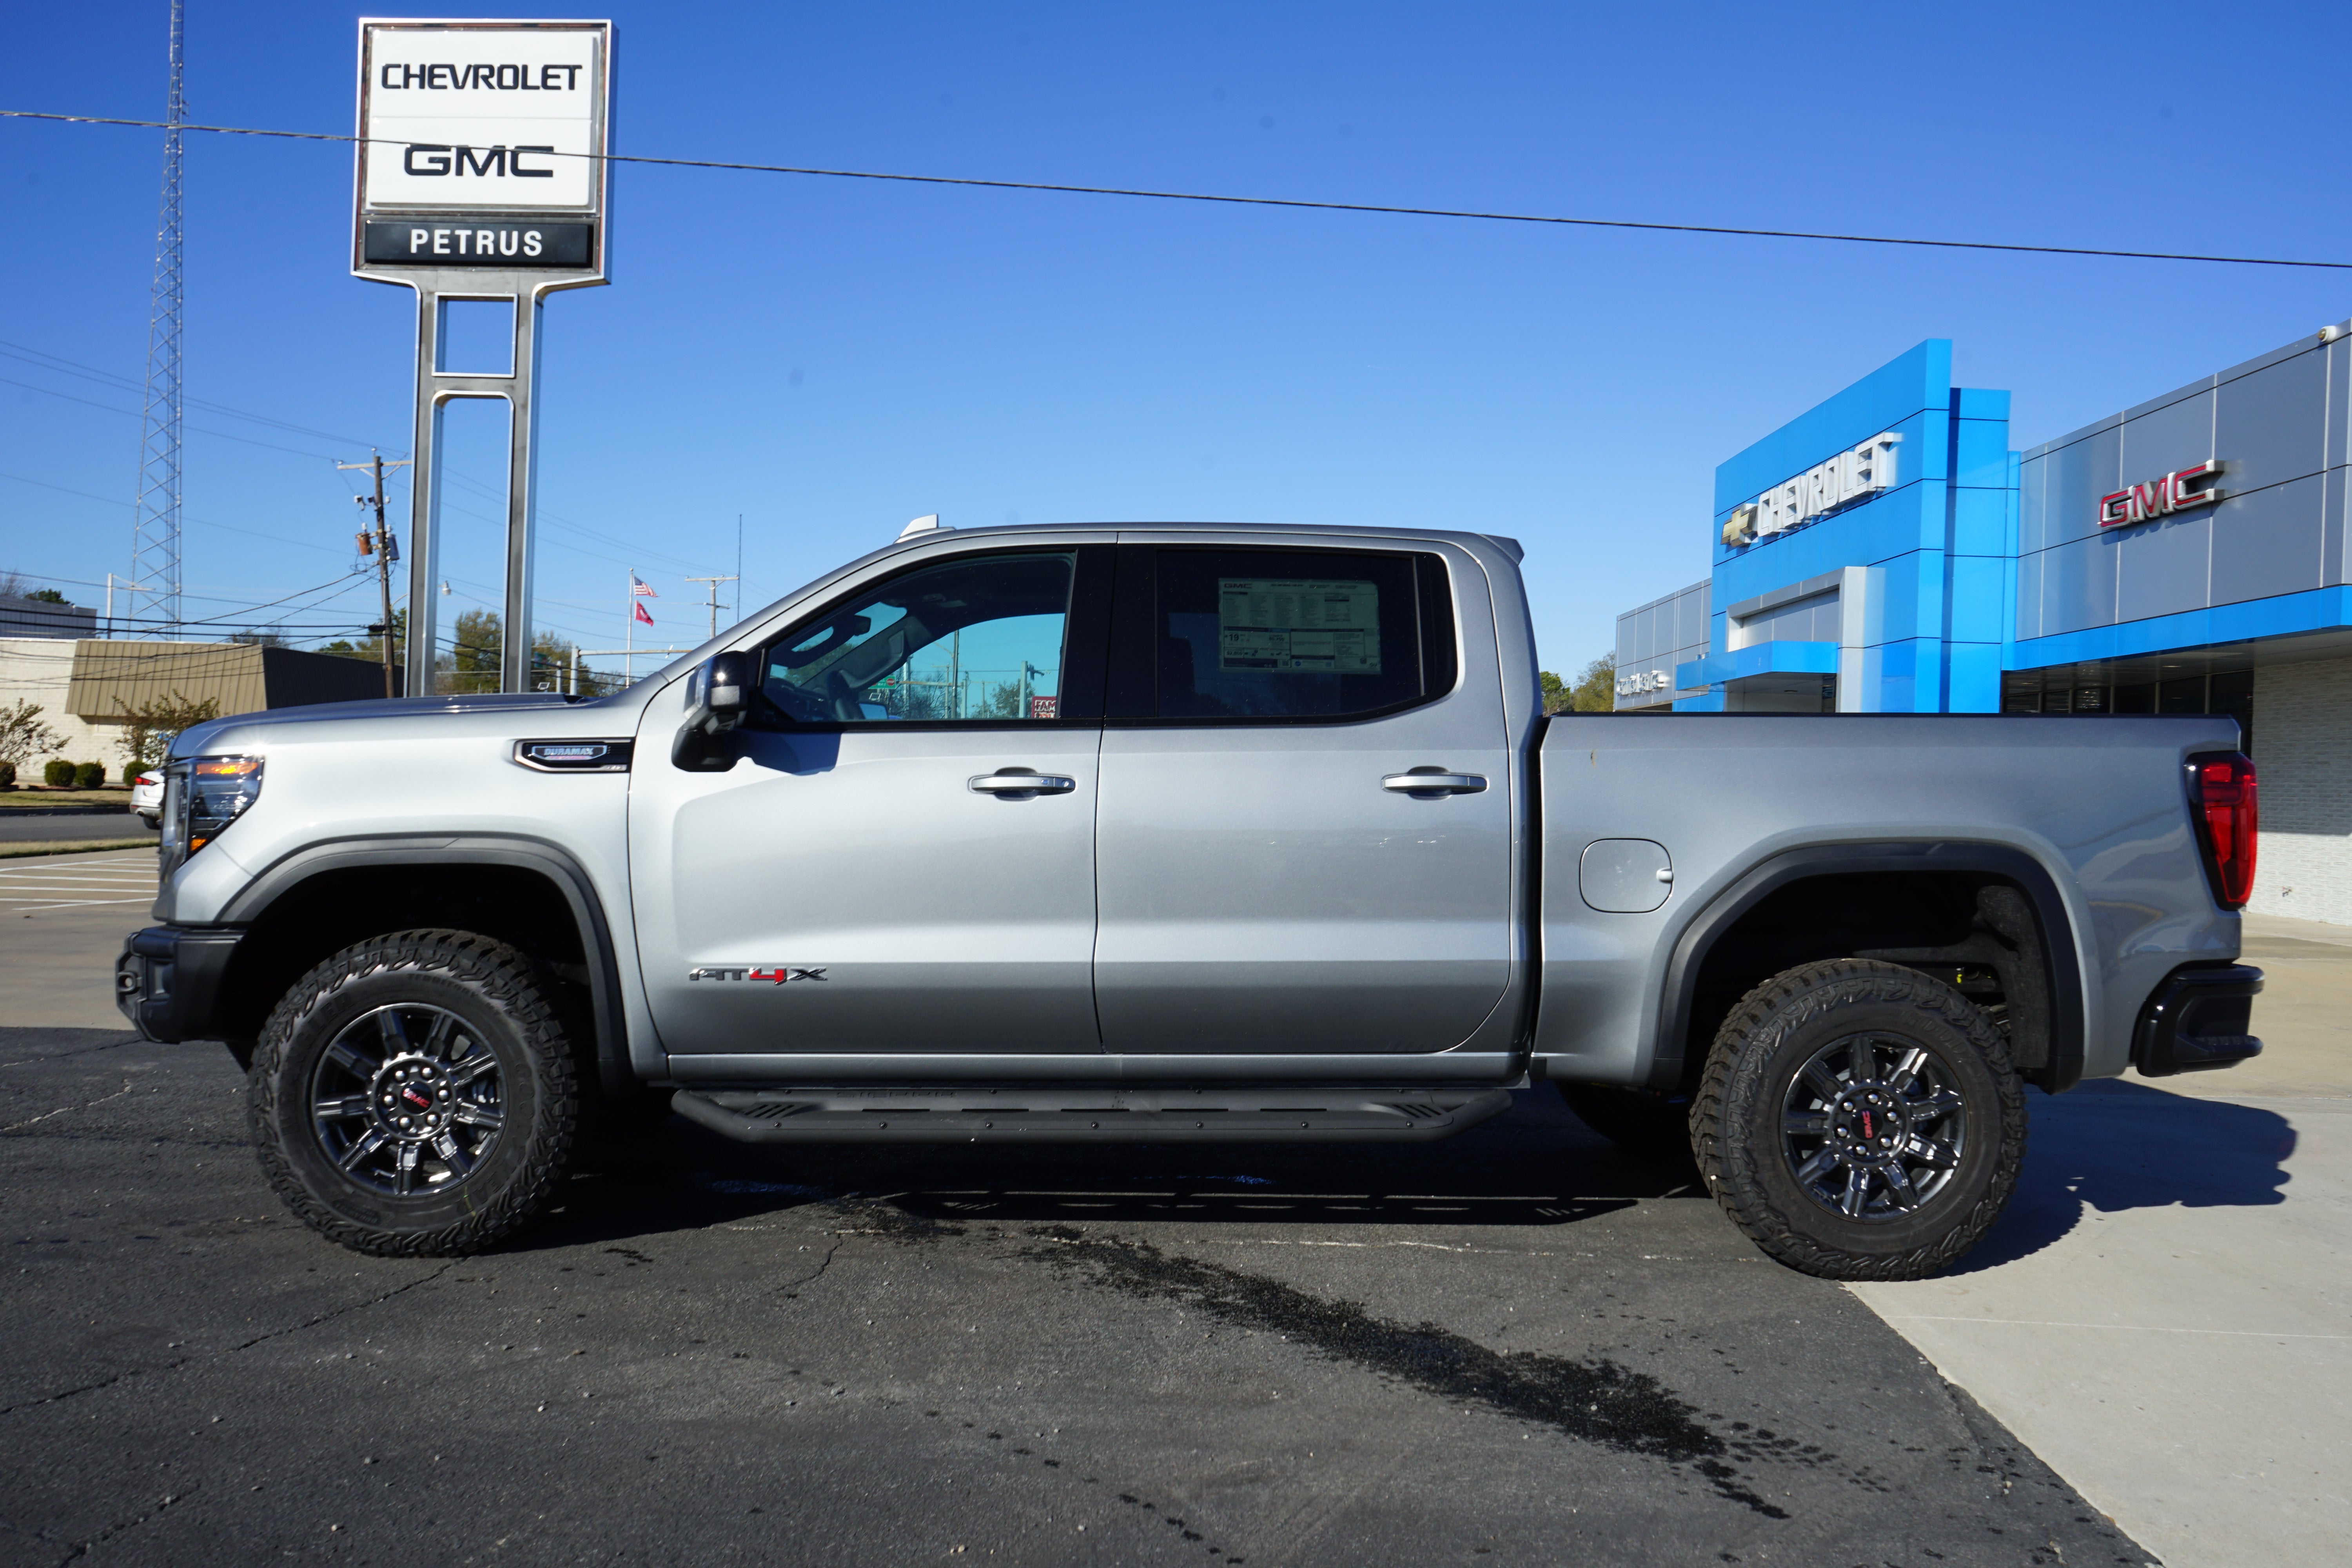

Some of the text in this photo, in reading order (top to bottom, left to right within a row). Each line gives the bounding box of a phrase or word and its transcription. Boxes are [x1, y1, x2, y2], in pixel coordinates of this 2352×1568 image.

[381, 64, 583, 90] CHEVROLET
[404, 144, 554, 177] GMC
[410, 229, 543, 256] PETRUS
[1757, 432, 1904, 537] CHEVROLET
[2099, 459, 2225, 531] GMC
[689, 966, 828, 985] AT4X
[402, 1087, 430, 1108] GMC
[1862, 1111, 1873, 1138] GMC
